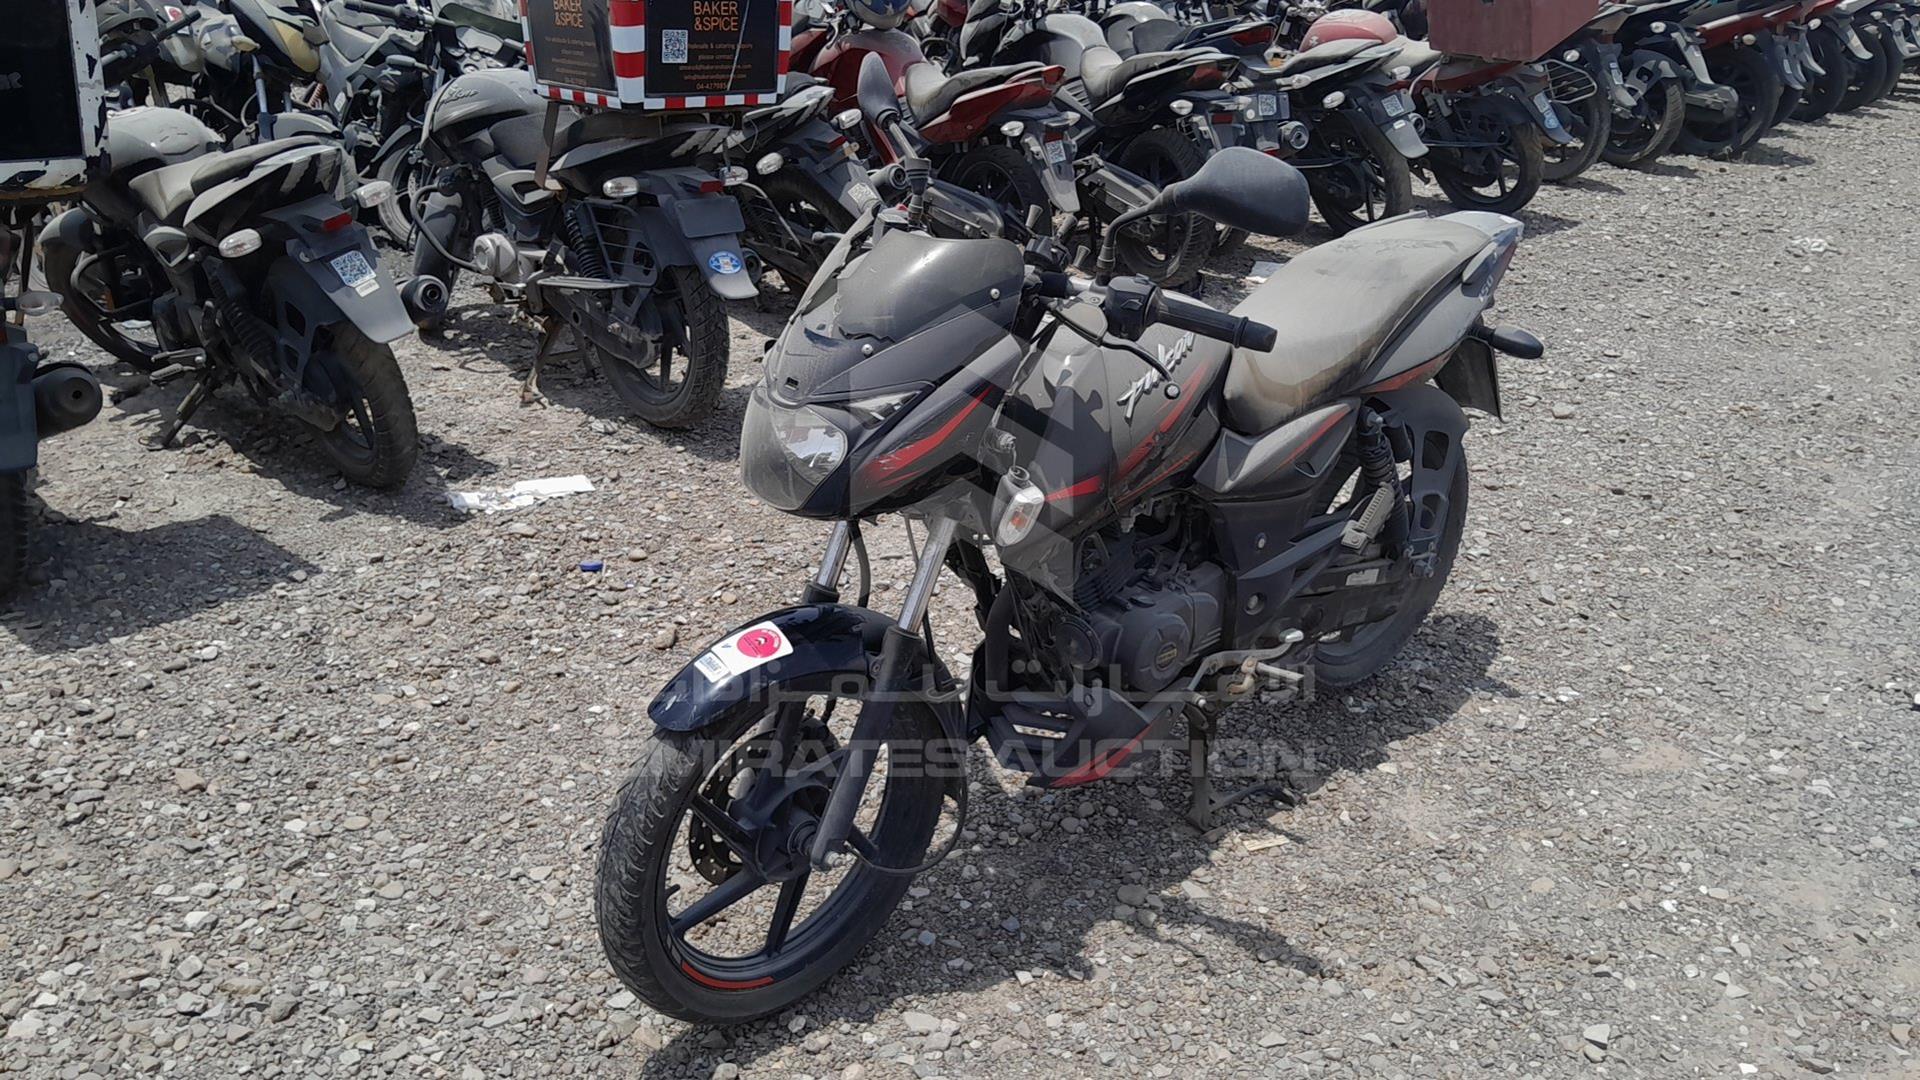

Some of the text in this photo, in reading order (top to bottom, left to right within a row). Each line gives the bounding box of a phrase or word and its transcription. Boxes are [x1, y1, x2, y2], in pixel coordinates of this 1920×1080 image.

[553, 0, 583, 12] BAKER
[693, 1, 738, 15] BAKER
[554, 12, 584, 28] &SPICE
[694, 16, 739, 31] &SPICE
